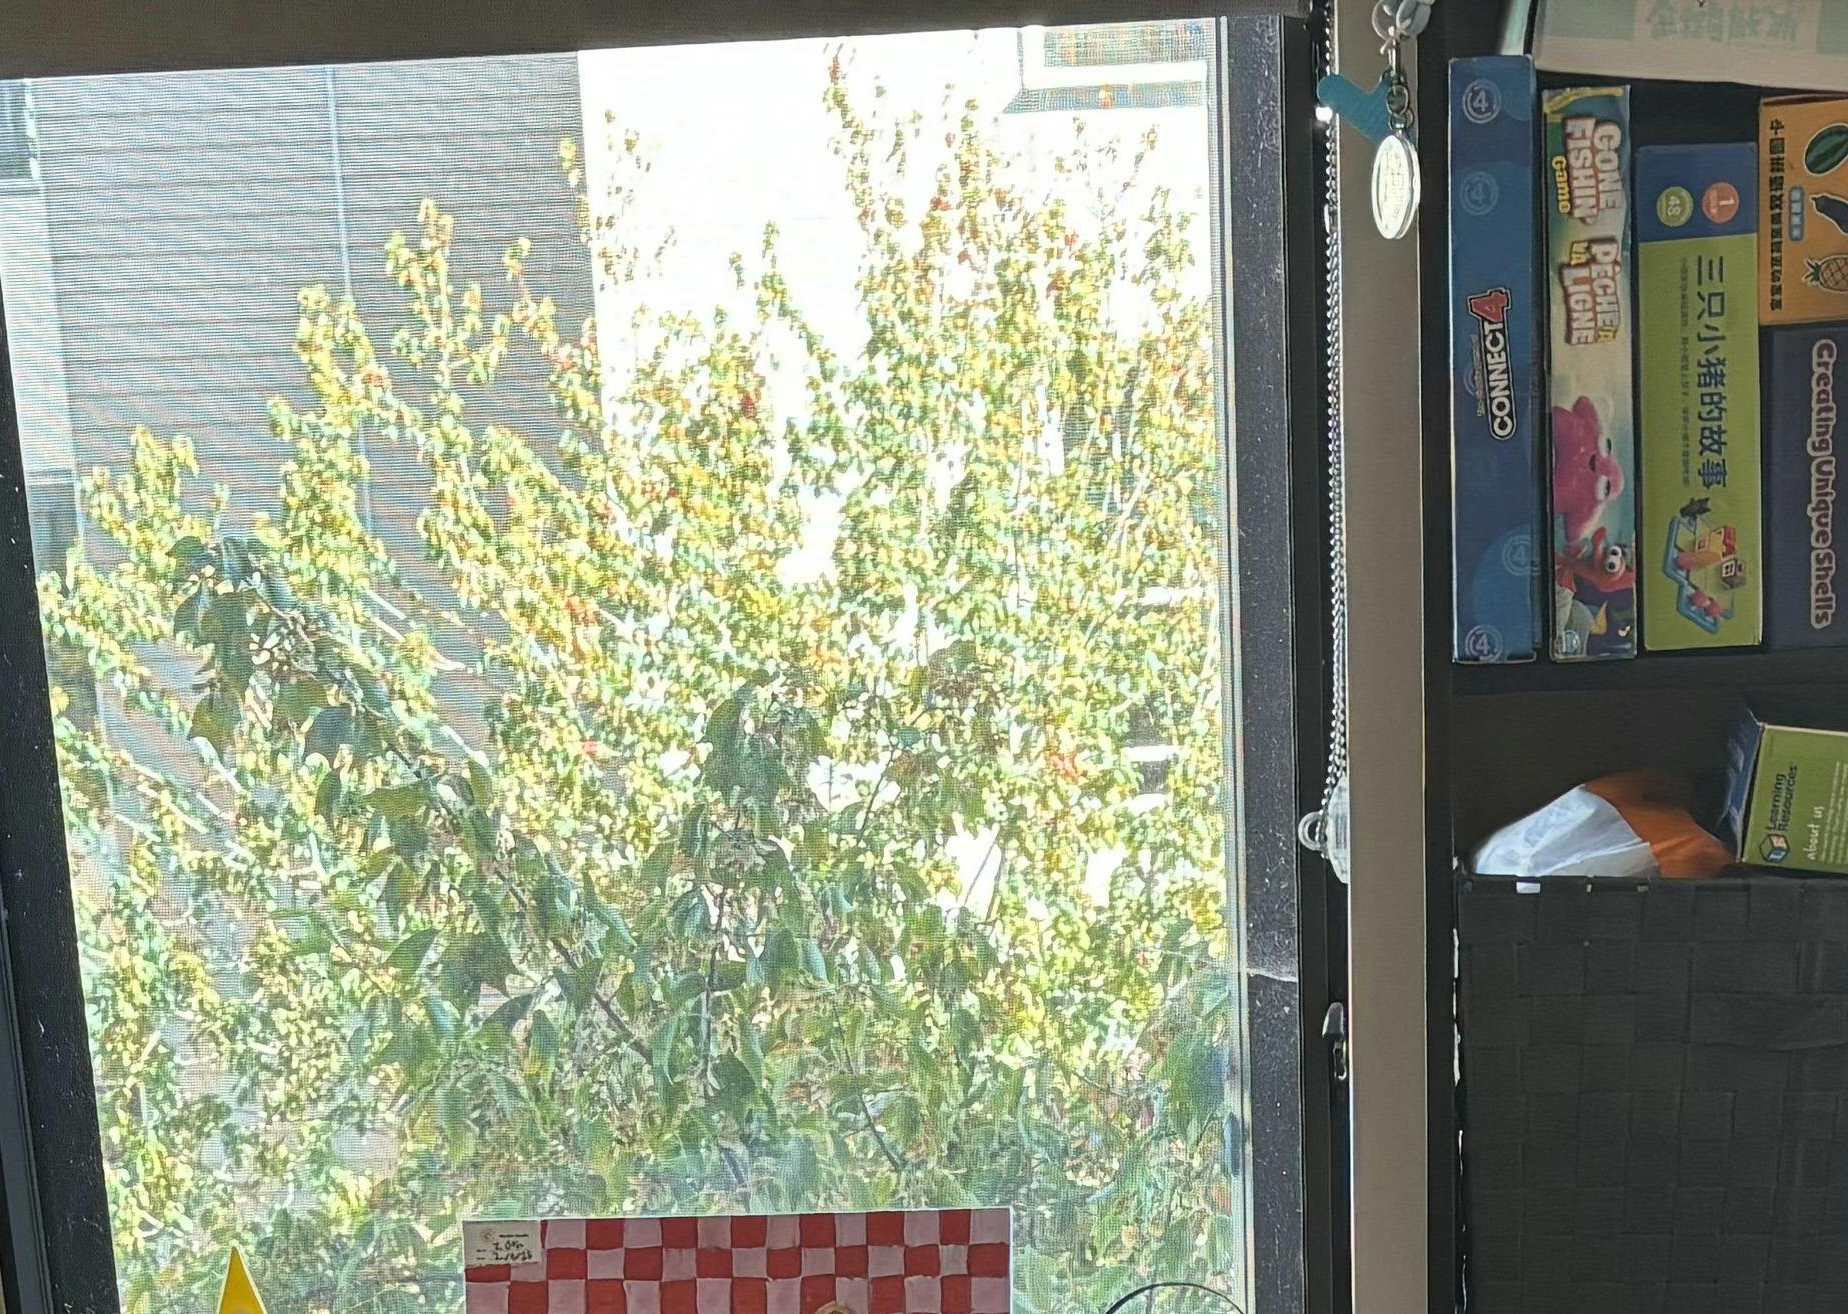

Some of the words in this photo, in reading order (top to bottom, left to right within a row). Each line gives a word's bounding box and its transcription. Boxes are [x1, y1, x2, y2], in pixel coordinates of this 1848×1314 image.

[1552, 156, 1570, 214] Game
[1594, 122, 1622, 211] GONE
[1665, 194, 1686, 217] 48
[1468, 289, 1510, 323] 4
[1563, 265, 1598, 346] LIGNE
[1591, 239, 1621, 330] PÊCHE
[1484, 321, 1514, 438] CONNECT
[1696, 255, 1727, 488] 三只小猪的故事
[1810, 341, 1836, 457] Creating
[1810, 456, 1836, 549] Unique
[1812, 549, 1836, 628] Shells
[1767, 773, 1785, 830] Learning
[1778, 763, 1798, 832] Resources
[1803, 823, 1821, 861] about
[1814, 805, 1825, 819] us
